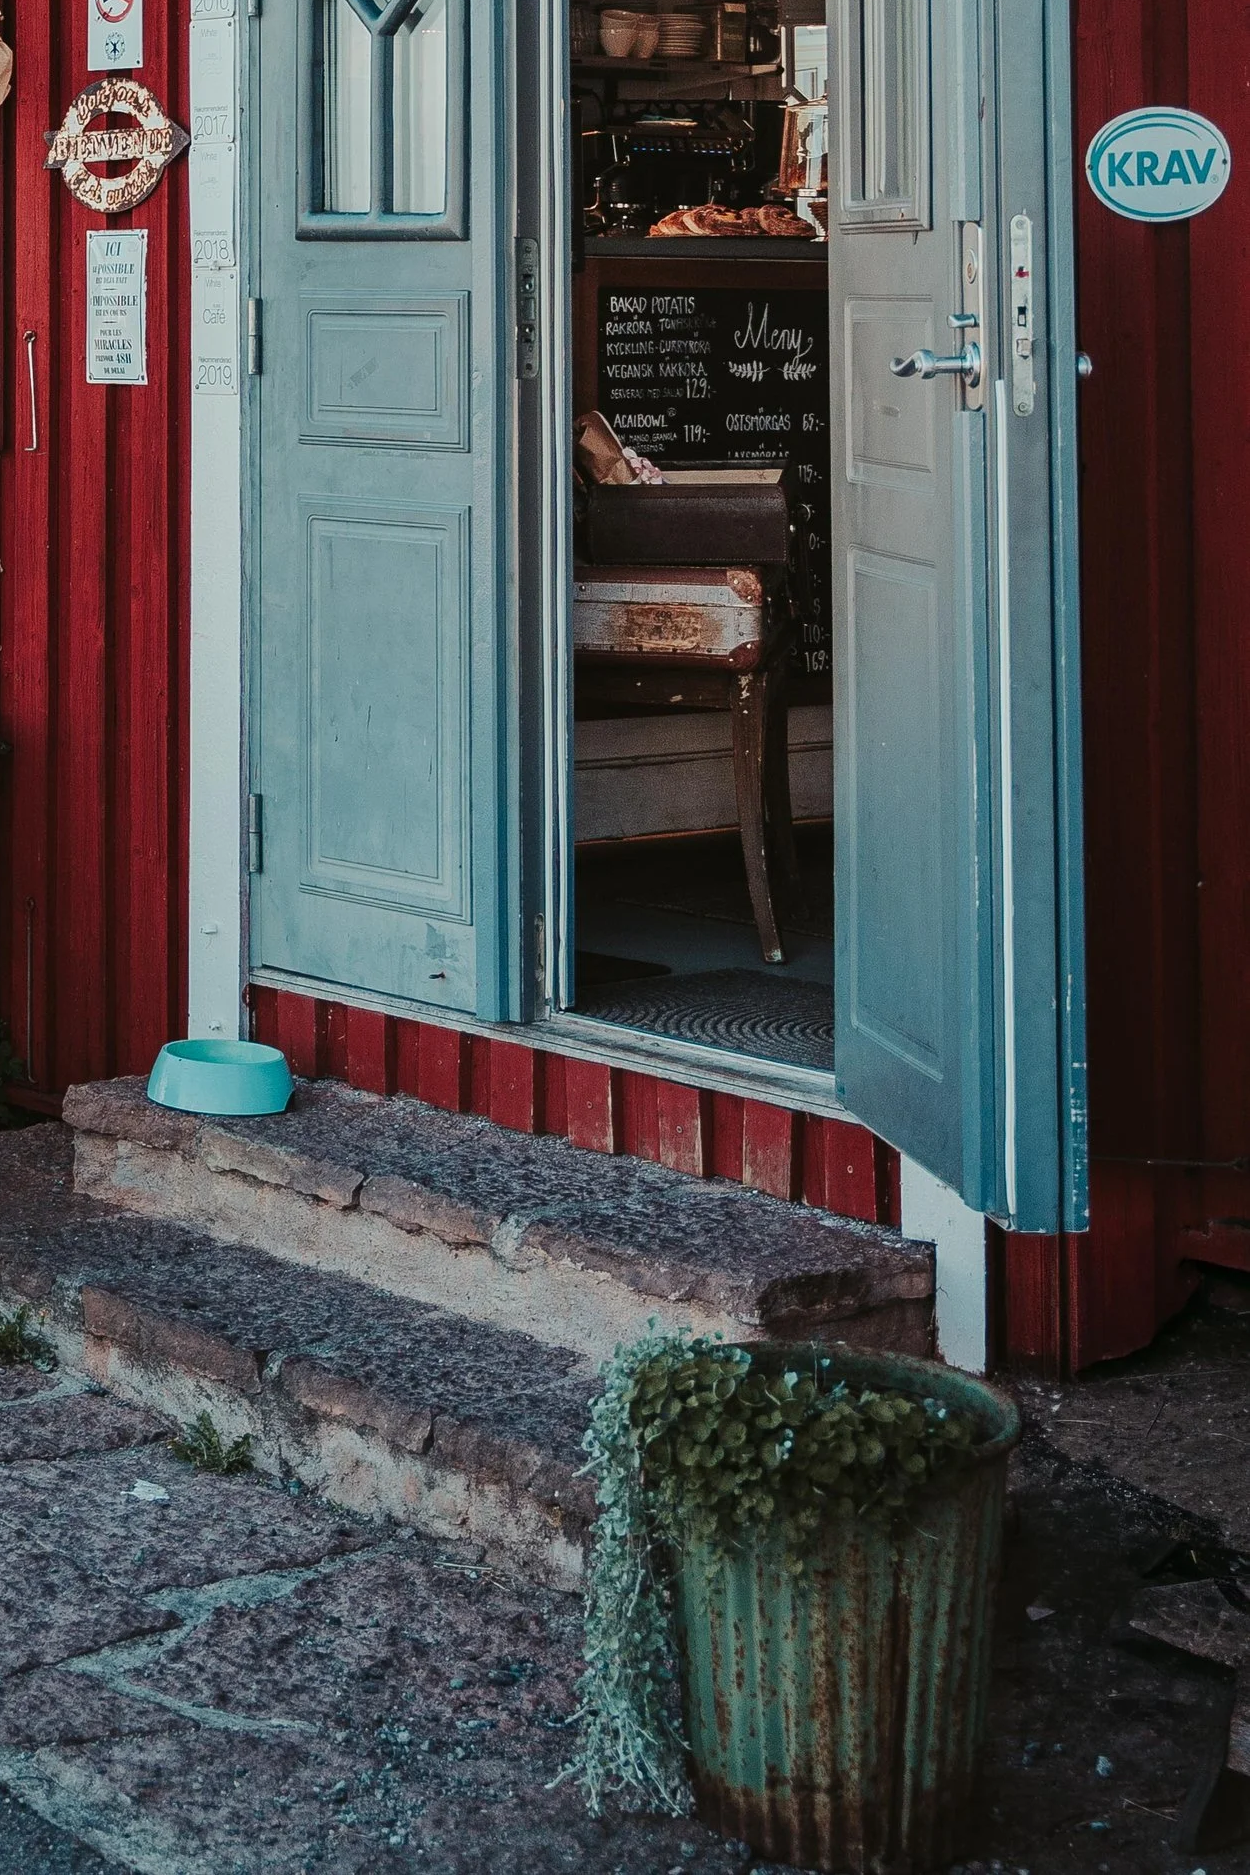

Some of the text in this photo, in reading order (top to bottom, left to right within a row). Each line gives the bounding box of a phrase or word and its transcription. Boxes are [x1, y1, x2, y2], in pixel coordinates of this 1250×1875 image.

[194, 114, 229, 138] 2017
[55, 127, 173, 161] BIENVENUE
[1107, 148, 1217, 187] KRAV
[105, 241, 121, 257] ICI
[194, 239, 230, 261] 2018
[97, 263, 135, 275] POSSIBLE
[205, 278, 222, 288] White
[610, 296, 695, 315] BAKAD POTATIS
[203, 308, 226, 325] Café
[94, 338, 133, 350] MIRACLES
[734, 301, 814, 371] Meny
[198, 364, 233, 387] 2019
[606, 363, 655, 379] VEGANSK
[613, 413, 668, 429] ACAIBOWL
